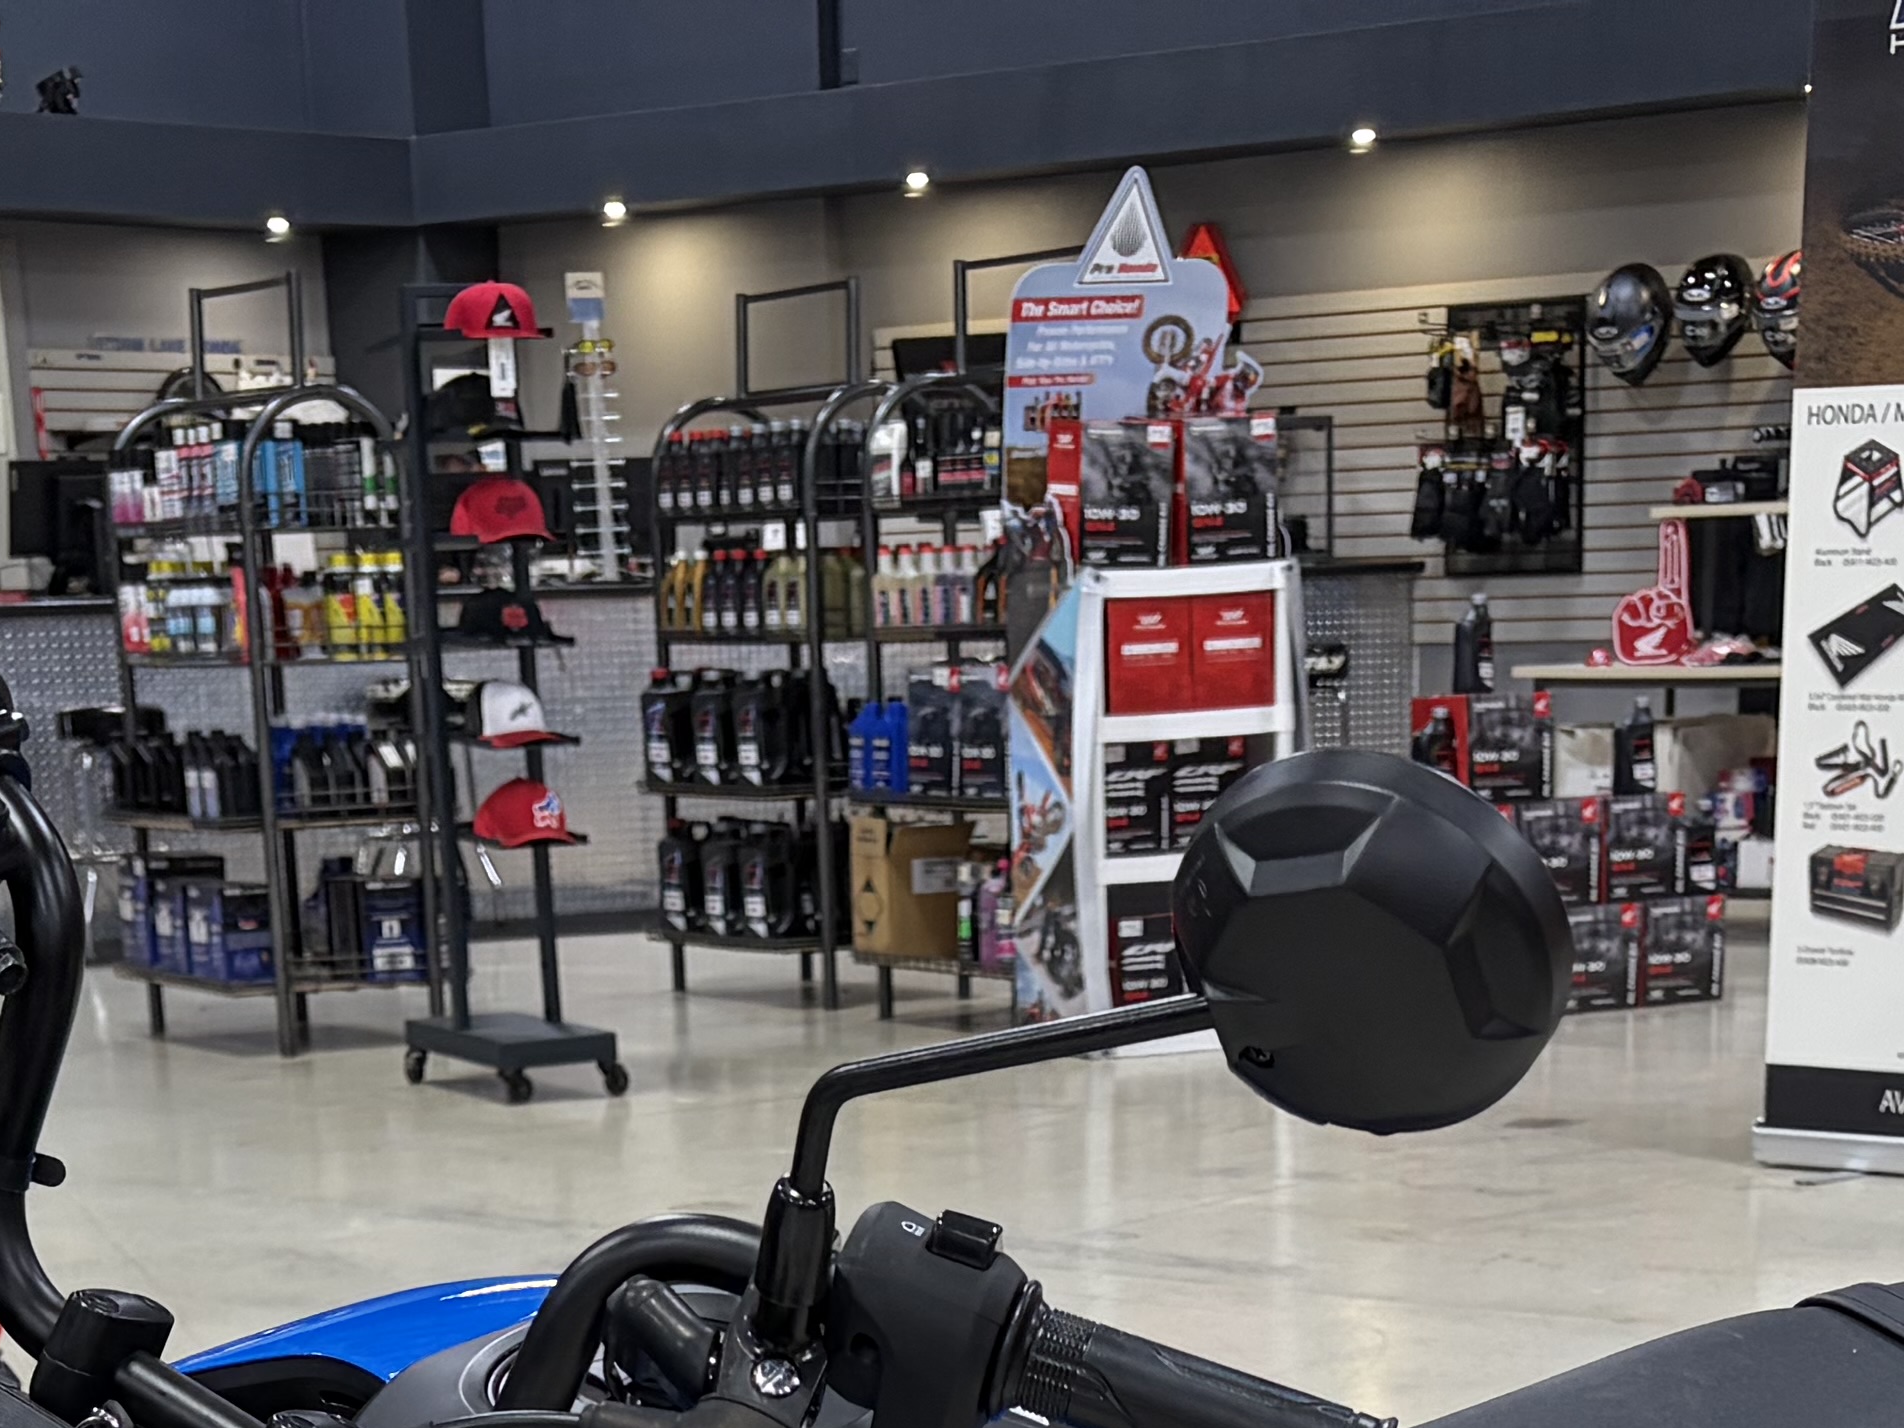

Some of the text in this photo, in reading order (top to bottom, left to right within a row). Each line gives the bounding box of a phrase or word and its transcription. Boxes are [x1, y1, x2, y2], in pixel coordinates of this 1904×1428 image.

[1046, 299, 1087, 317] Smart
[1807, 404, 1877, 425] HONDA
[1880, 403, 1891, 423] /
